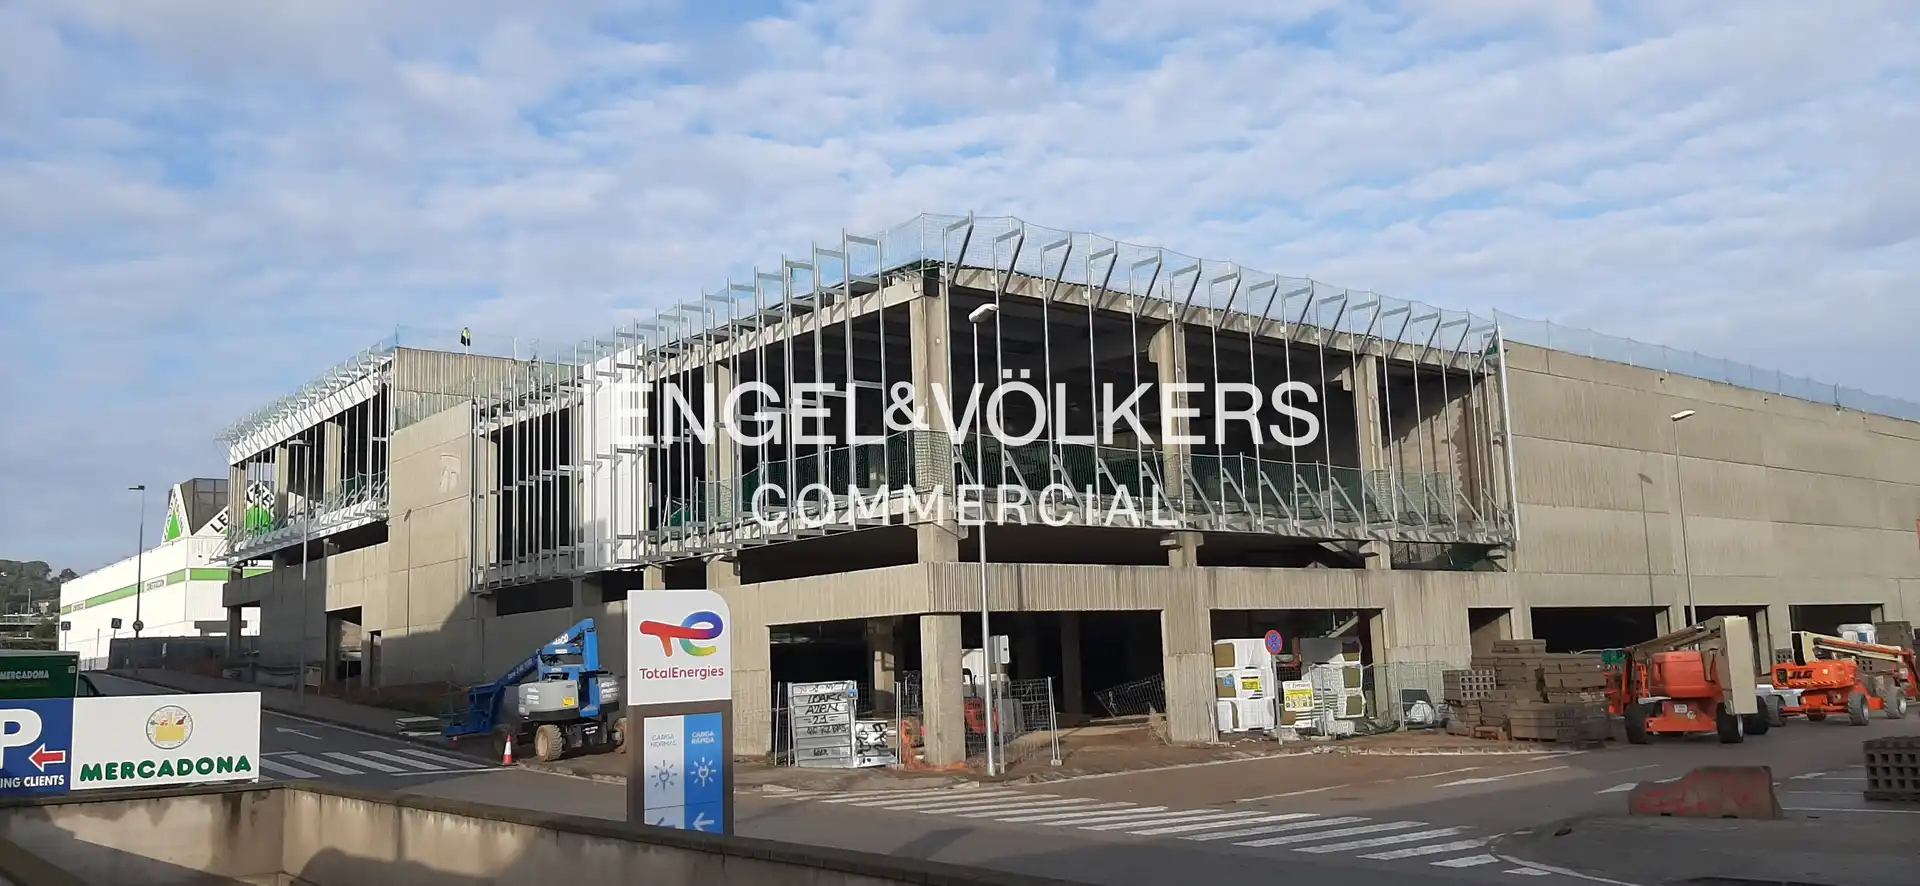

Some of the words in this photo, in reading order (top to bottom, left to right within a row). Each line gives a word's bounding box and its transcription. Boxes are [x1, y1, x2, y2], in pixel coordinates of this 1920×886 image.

[0, 670, 50, 680] MERCADONA
[639, 665, 724, 680] TotalEnergies
[1789, 670, 1815, 679] JLG
[651, 732, 675, 741] CARGA
[691, 730, 715, 738] CARGA
[650, 740, 676, 748] NORMAL
[79, 757, 252, 782] MERCADONA
[23, 774, 65, 787] CLIENTS
